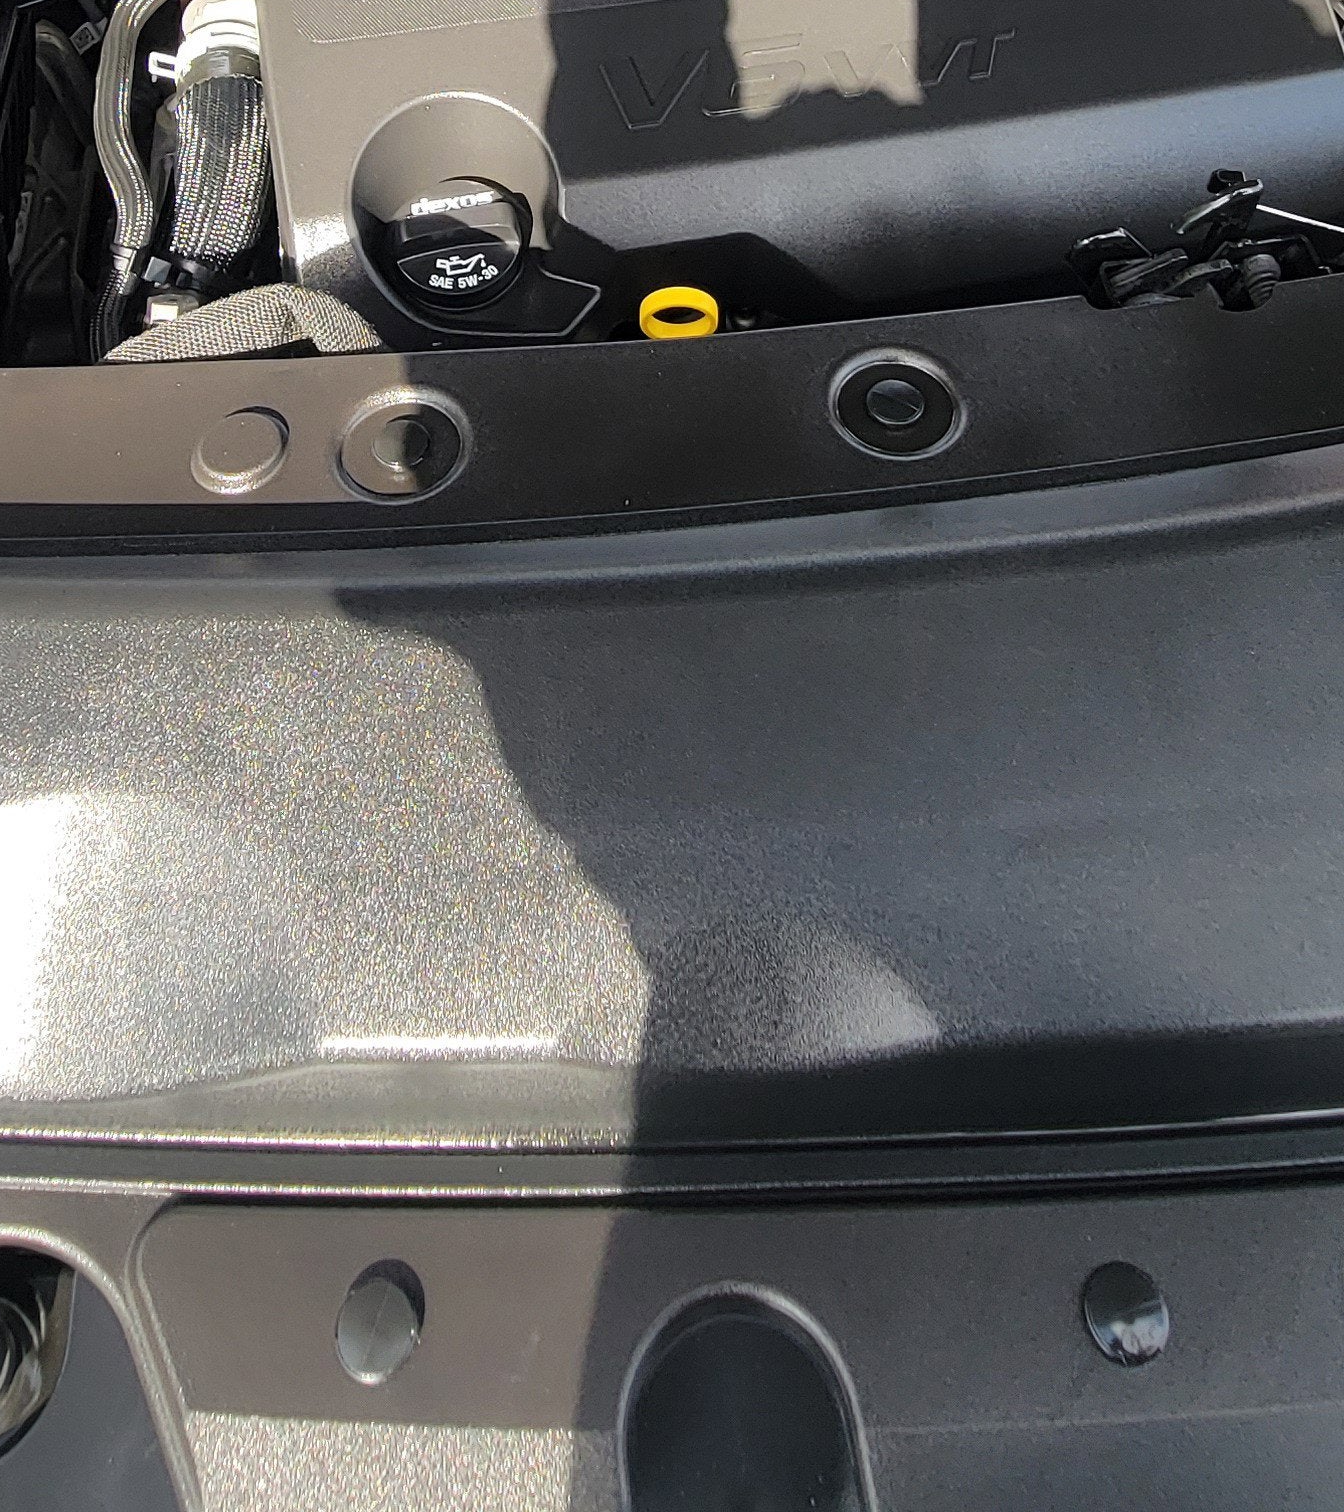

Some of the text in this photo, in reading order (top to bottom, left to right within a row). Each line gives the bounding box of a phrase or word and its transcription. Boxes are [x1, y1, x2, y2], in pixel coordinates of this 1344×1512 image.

[597, 32, 806, 130] V6
[410, 191, 494, 216] dexos
[428, 264, 499, 289] SAE 5W-30
